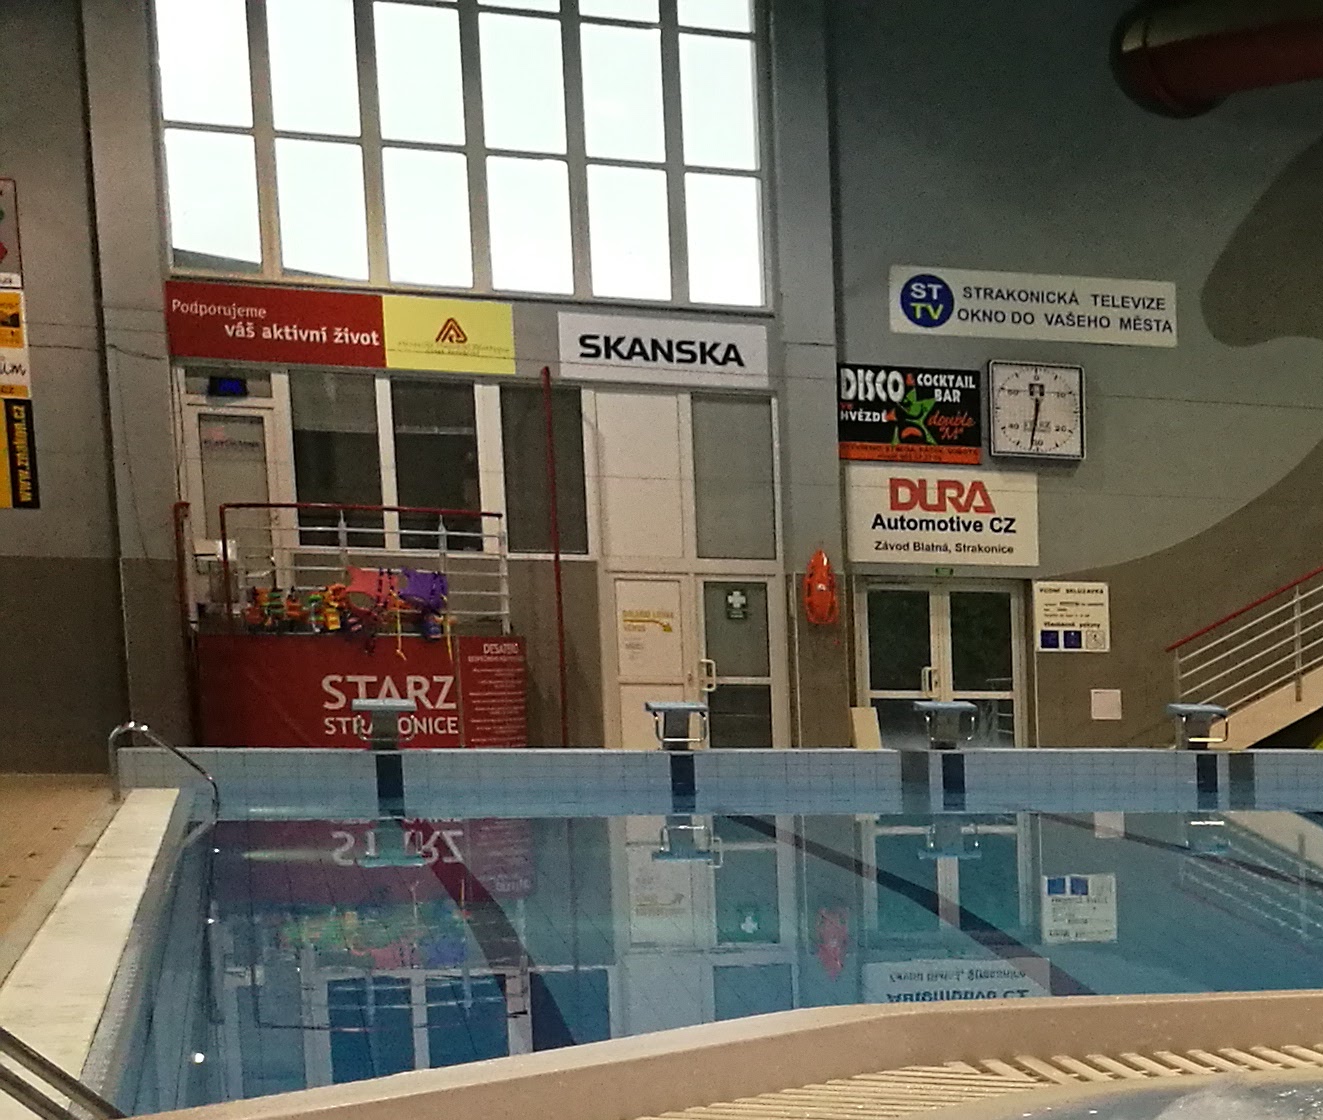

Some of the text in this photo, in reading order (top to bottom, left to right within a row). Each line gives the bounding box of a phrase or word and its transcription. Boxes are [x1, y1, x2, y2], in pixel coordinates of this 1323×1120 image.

[910, 282, 942, 300] ST
[963, 286, 1166, 311] STRAKONICKÁ TELEVIZE
[172, 299, 267, 319] Podporujeme
[910, 302, 944, 320] TV
[957, 308, 1173, 333] OKNO DO VAŠEHO MĚSTA
[224, 322, 380, 346] váš aktivní život
[579, 334, 745, 367] SKANSKA
[840, 368, 905, 403] DISCO
[917, 373, 976, 389] COCKTAIL
[934, 389, 961, 403] BAR
[889, 478, 995, 514] DURA
[871, 514, 1016, 533] Automotive CZ
[874, 541, 1014, 554] Závod Blatná, Strakonice
[321, 674, 457, 710] STARZ
[324, 716, 459, 735] STRONICE
